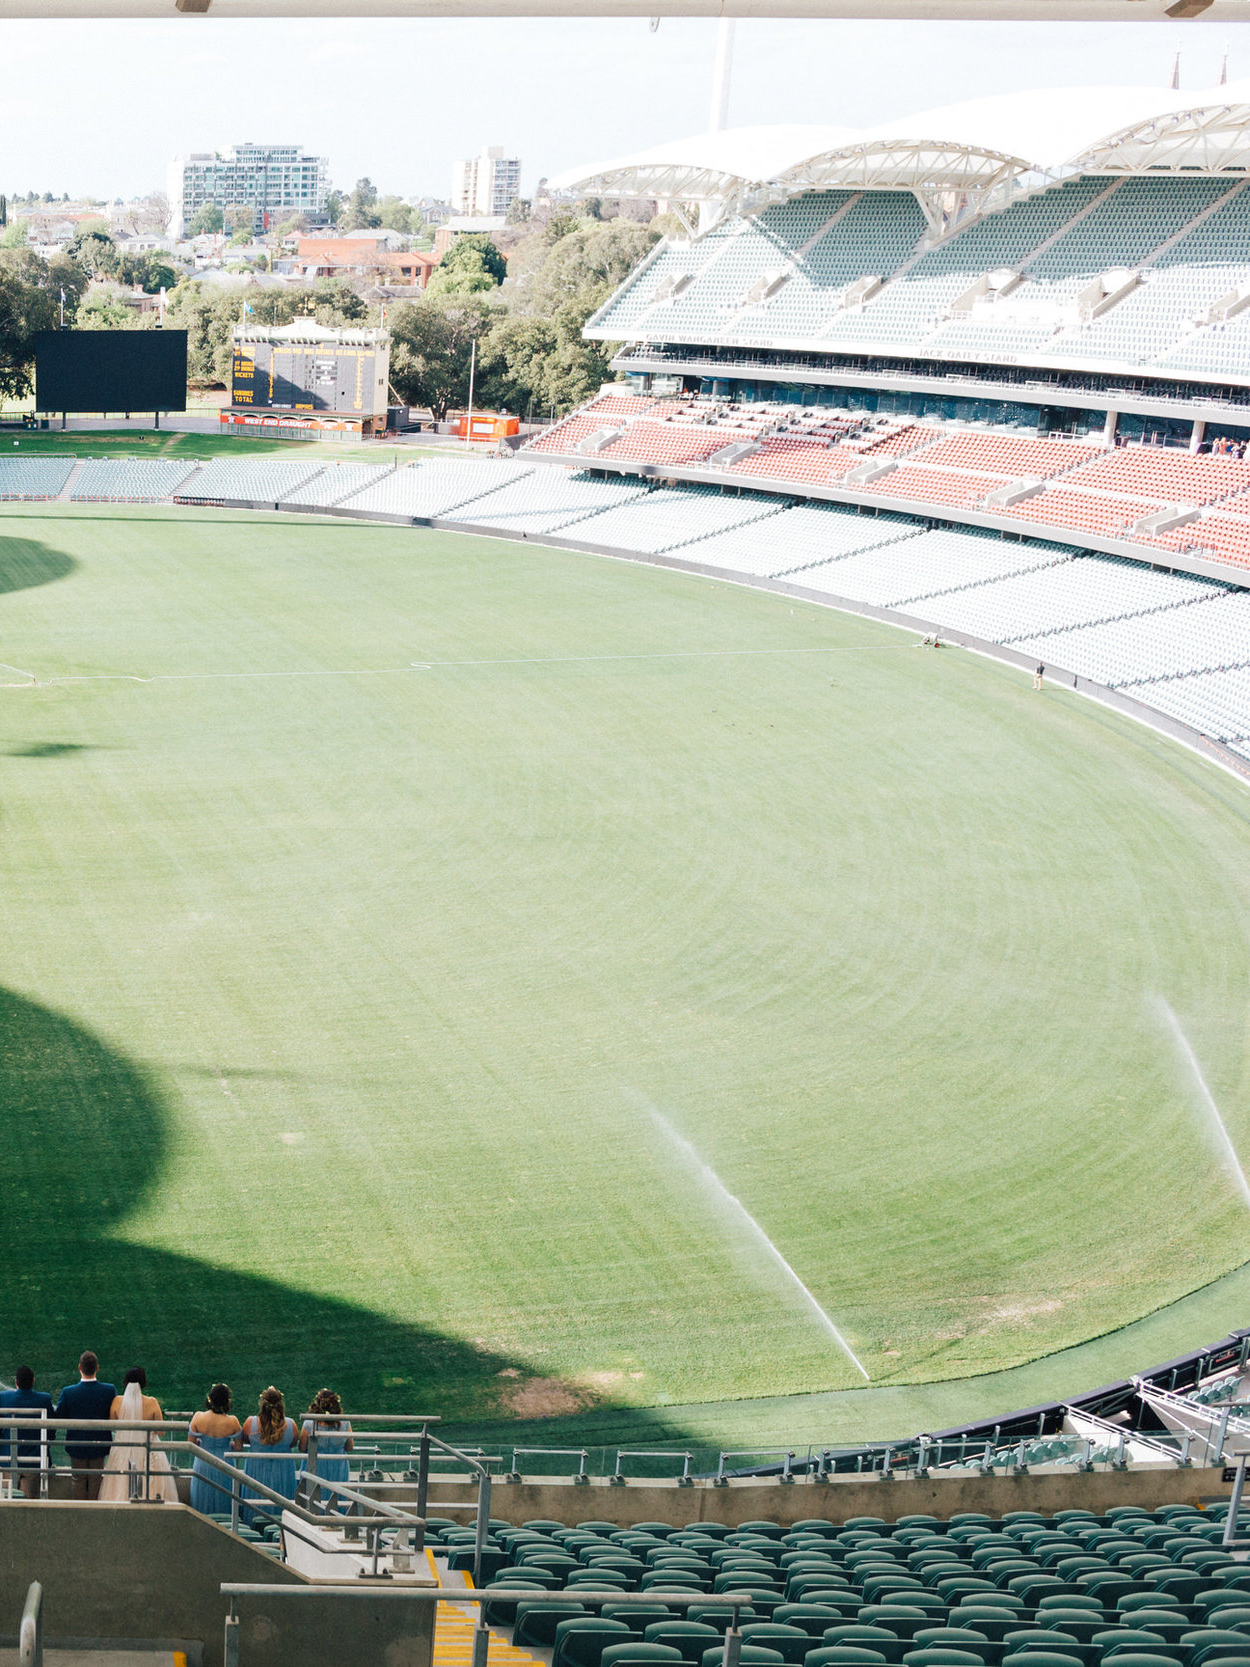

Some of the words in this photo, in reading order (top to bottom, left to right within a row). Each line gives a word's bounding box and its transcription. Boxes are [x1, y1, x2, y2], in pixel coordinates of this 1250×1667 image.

[743, 338, 774, 347] STAND
[919, 348, 943, 358] JACK
[983, 352, 1018, 363] STAND
[263, 418, 278, 426] END
[278, 420, 313, 428] DRAUGHT
